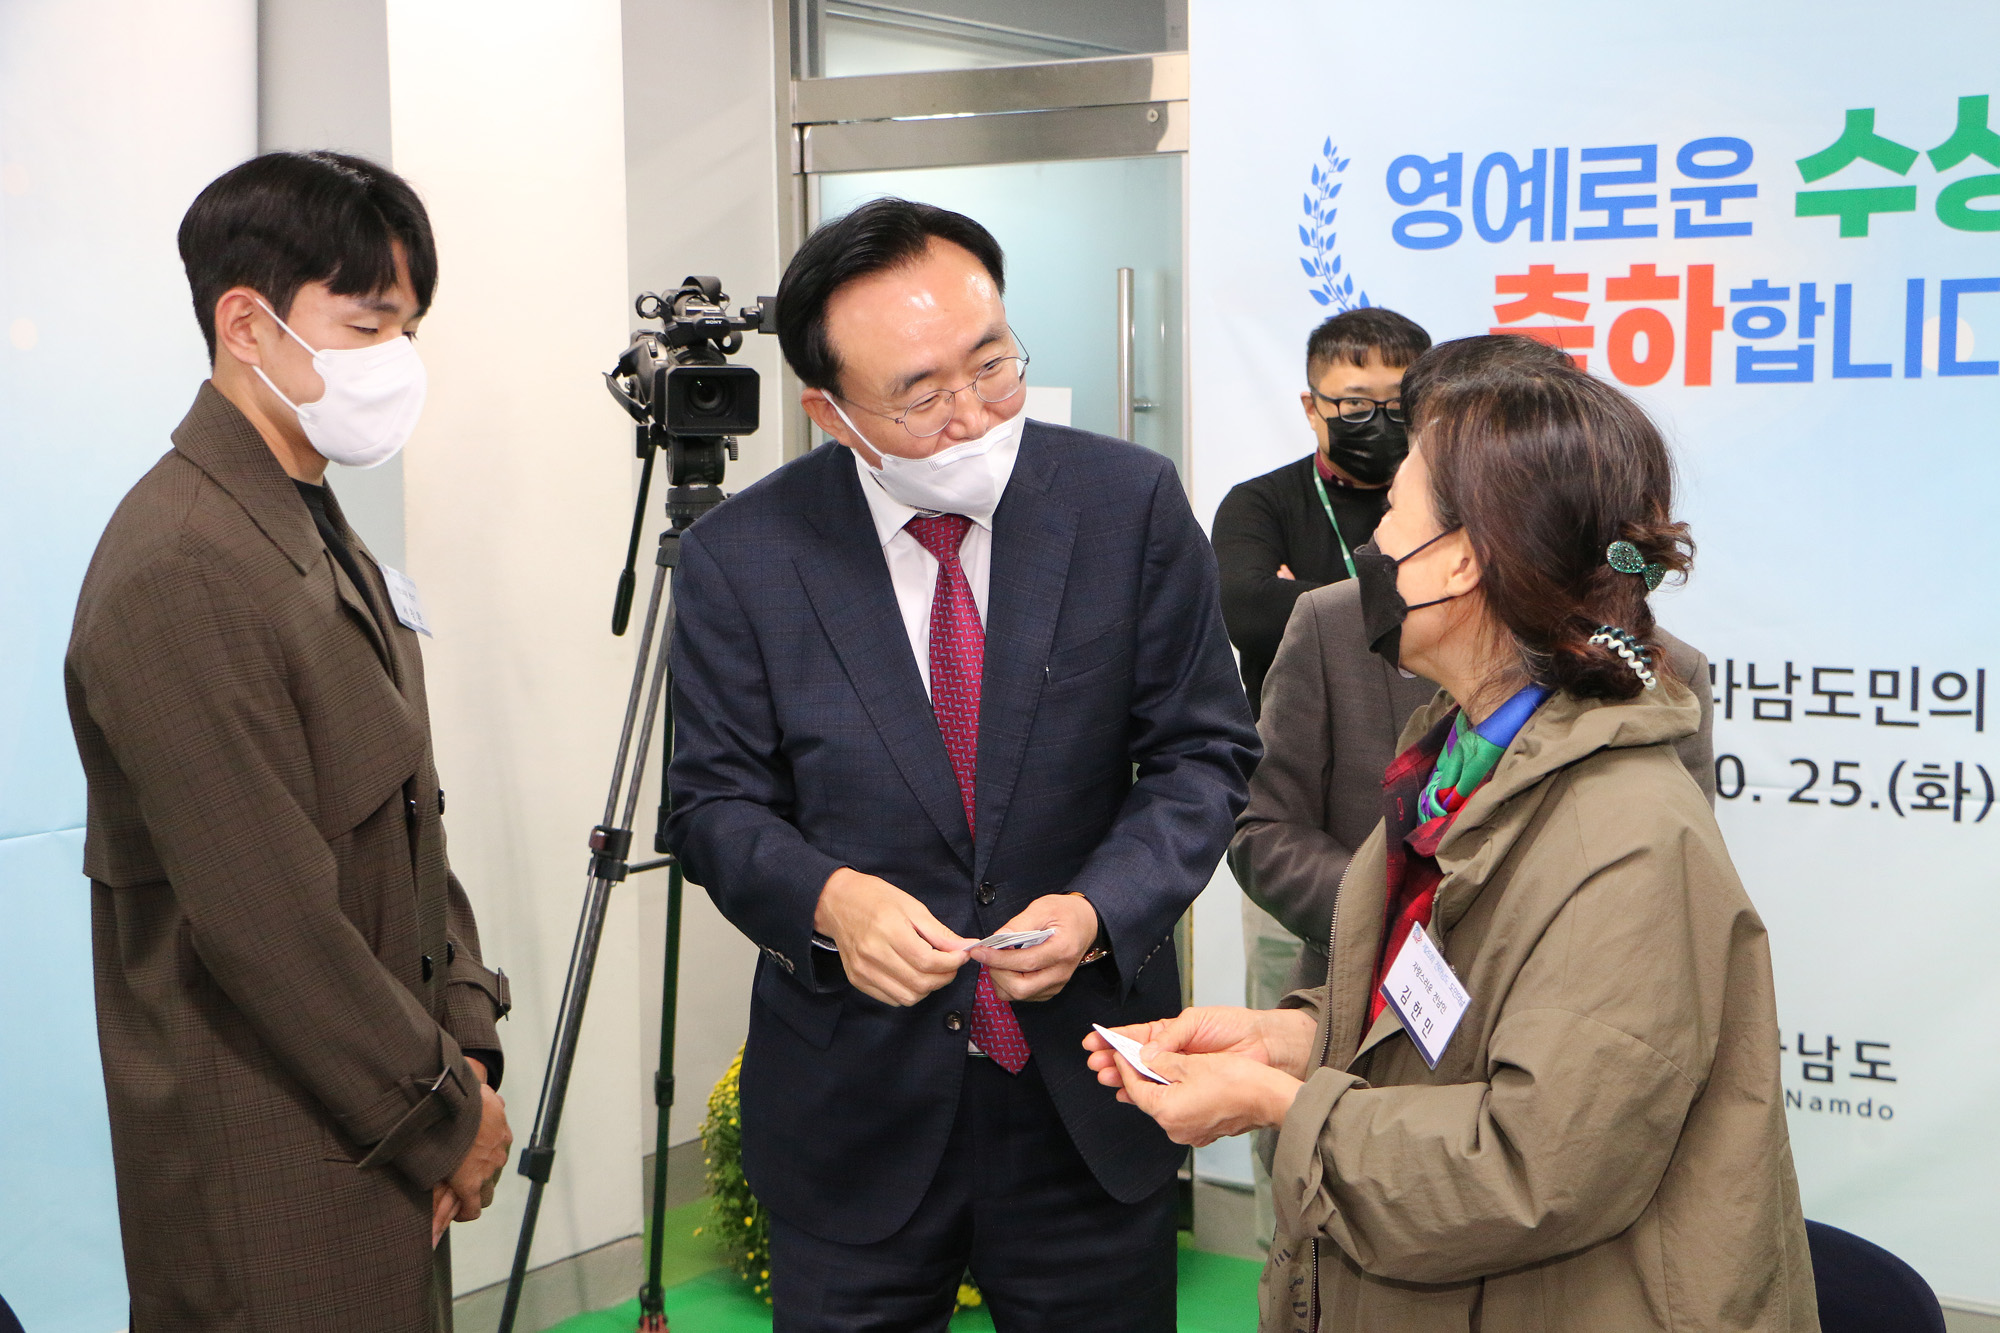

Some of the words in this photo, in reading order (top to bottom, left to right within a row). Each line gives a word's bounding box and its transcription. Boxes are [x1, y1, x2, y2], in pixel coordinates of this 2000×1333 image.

[1385, 135, 1758, 251] 영예로운
[1788, 758, 1995, 823] 25.(화)
[1412, 961, 1433, 994] 자랑스러운
[1432, 991, 1448, 1015] 전남인
[1778, 1028, 1897, 1085] 남도
